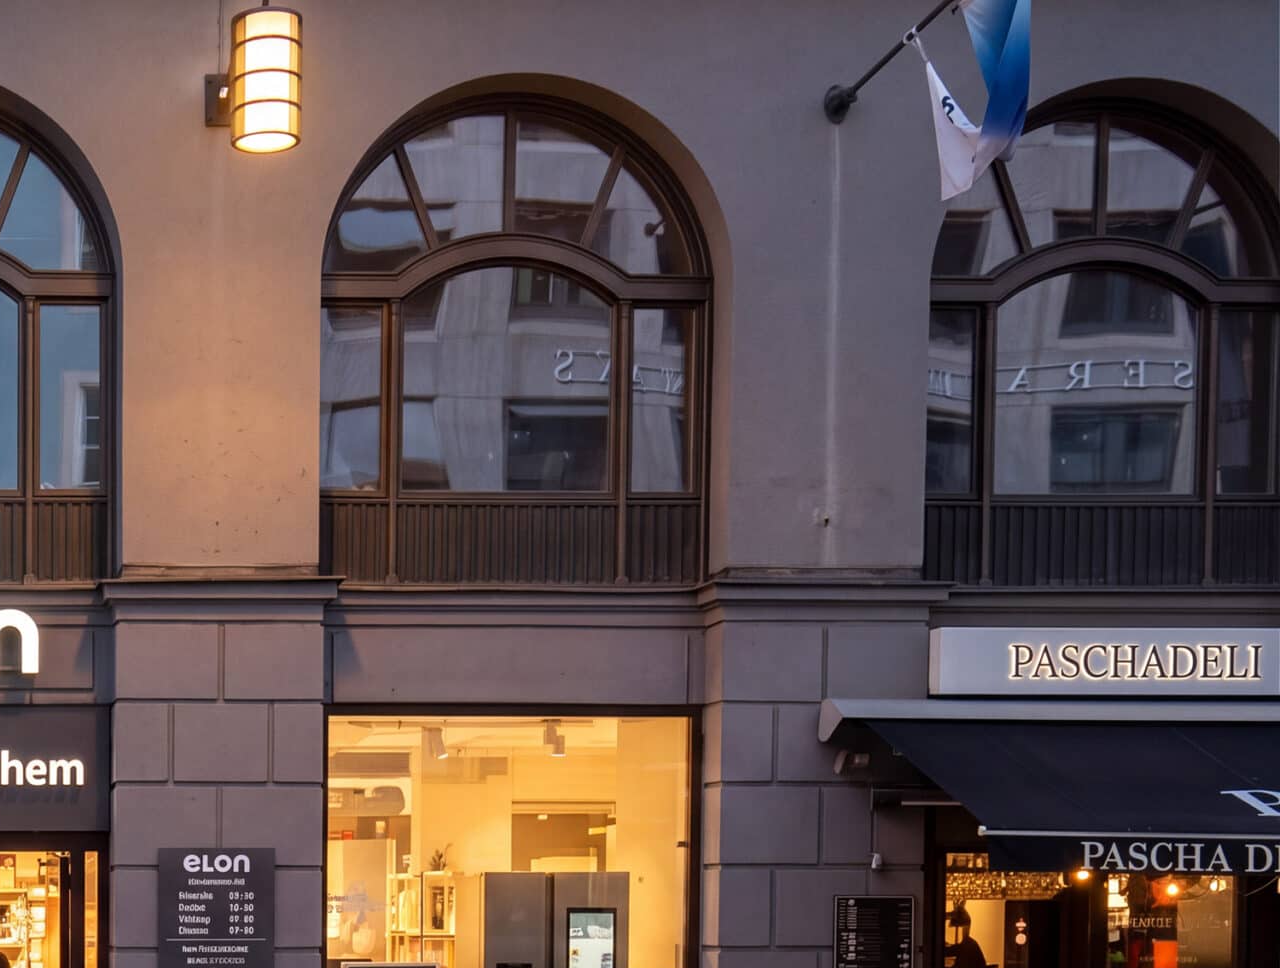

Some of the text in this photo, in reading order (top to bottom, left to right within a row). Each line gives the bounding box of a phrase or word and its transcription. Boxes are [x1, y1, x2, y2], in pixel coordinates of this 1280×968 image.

[1009, 642, 1263, 680] PASCHADELI
[0, 750, 85, 787] hem
[1081, 841, 1233, 873] PASCHA
